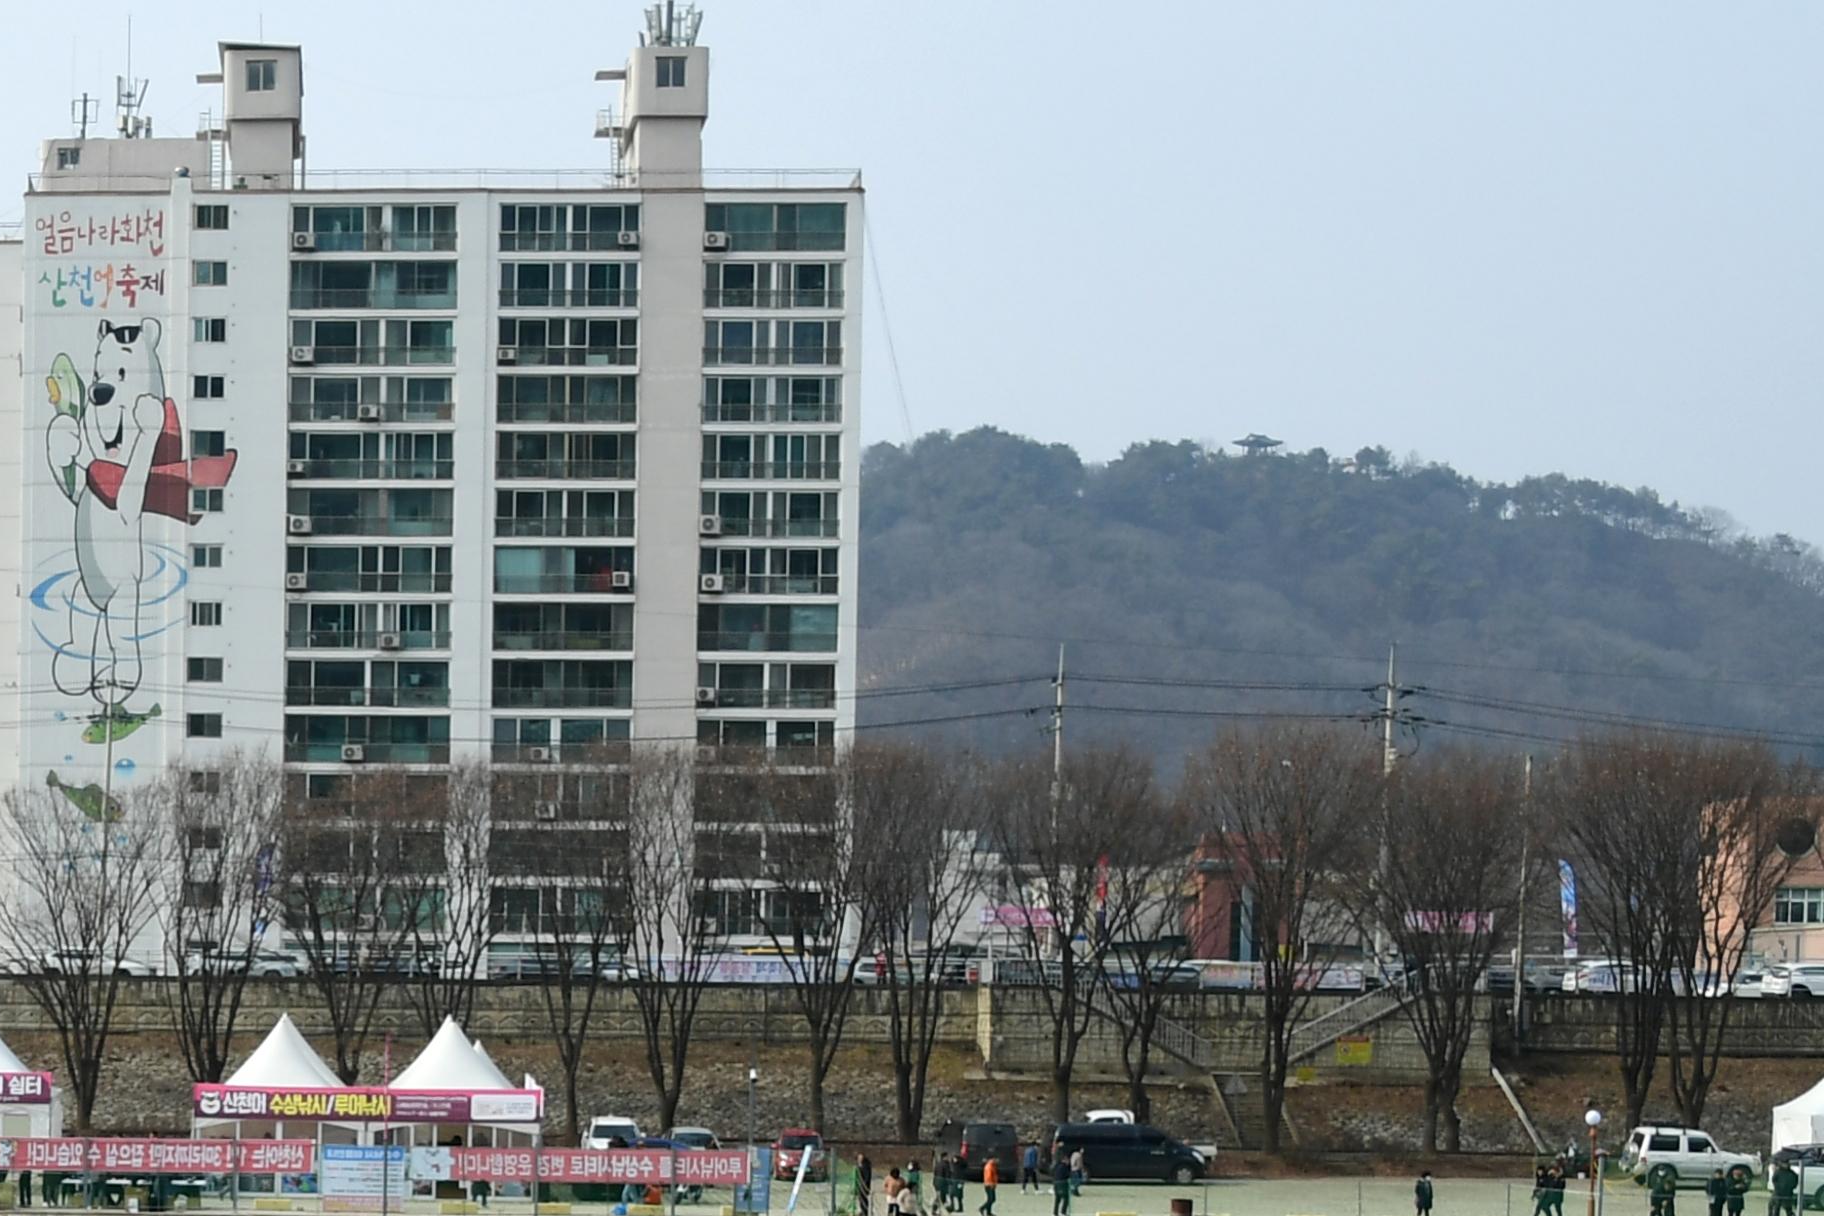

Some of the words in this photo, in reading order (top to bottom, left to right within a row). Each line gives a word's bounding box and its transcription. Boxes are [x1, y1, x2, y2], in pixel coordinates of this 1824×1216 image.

[35, 210, 165, 257] 얼음나라화천
[37, 264, 166, 309] 산천어축제
[222, 1092, 267, 1114] 산천어
